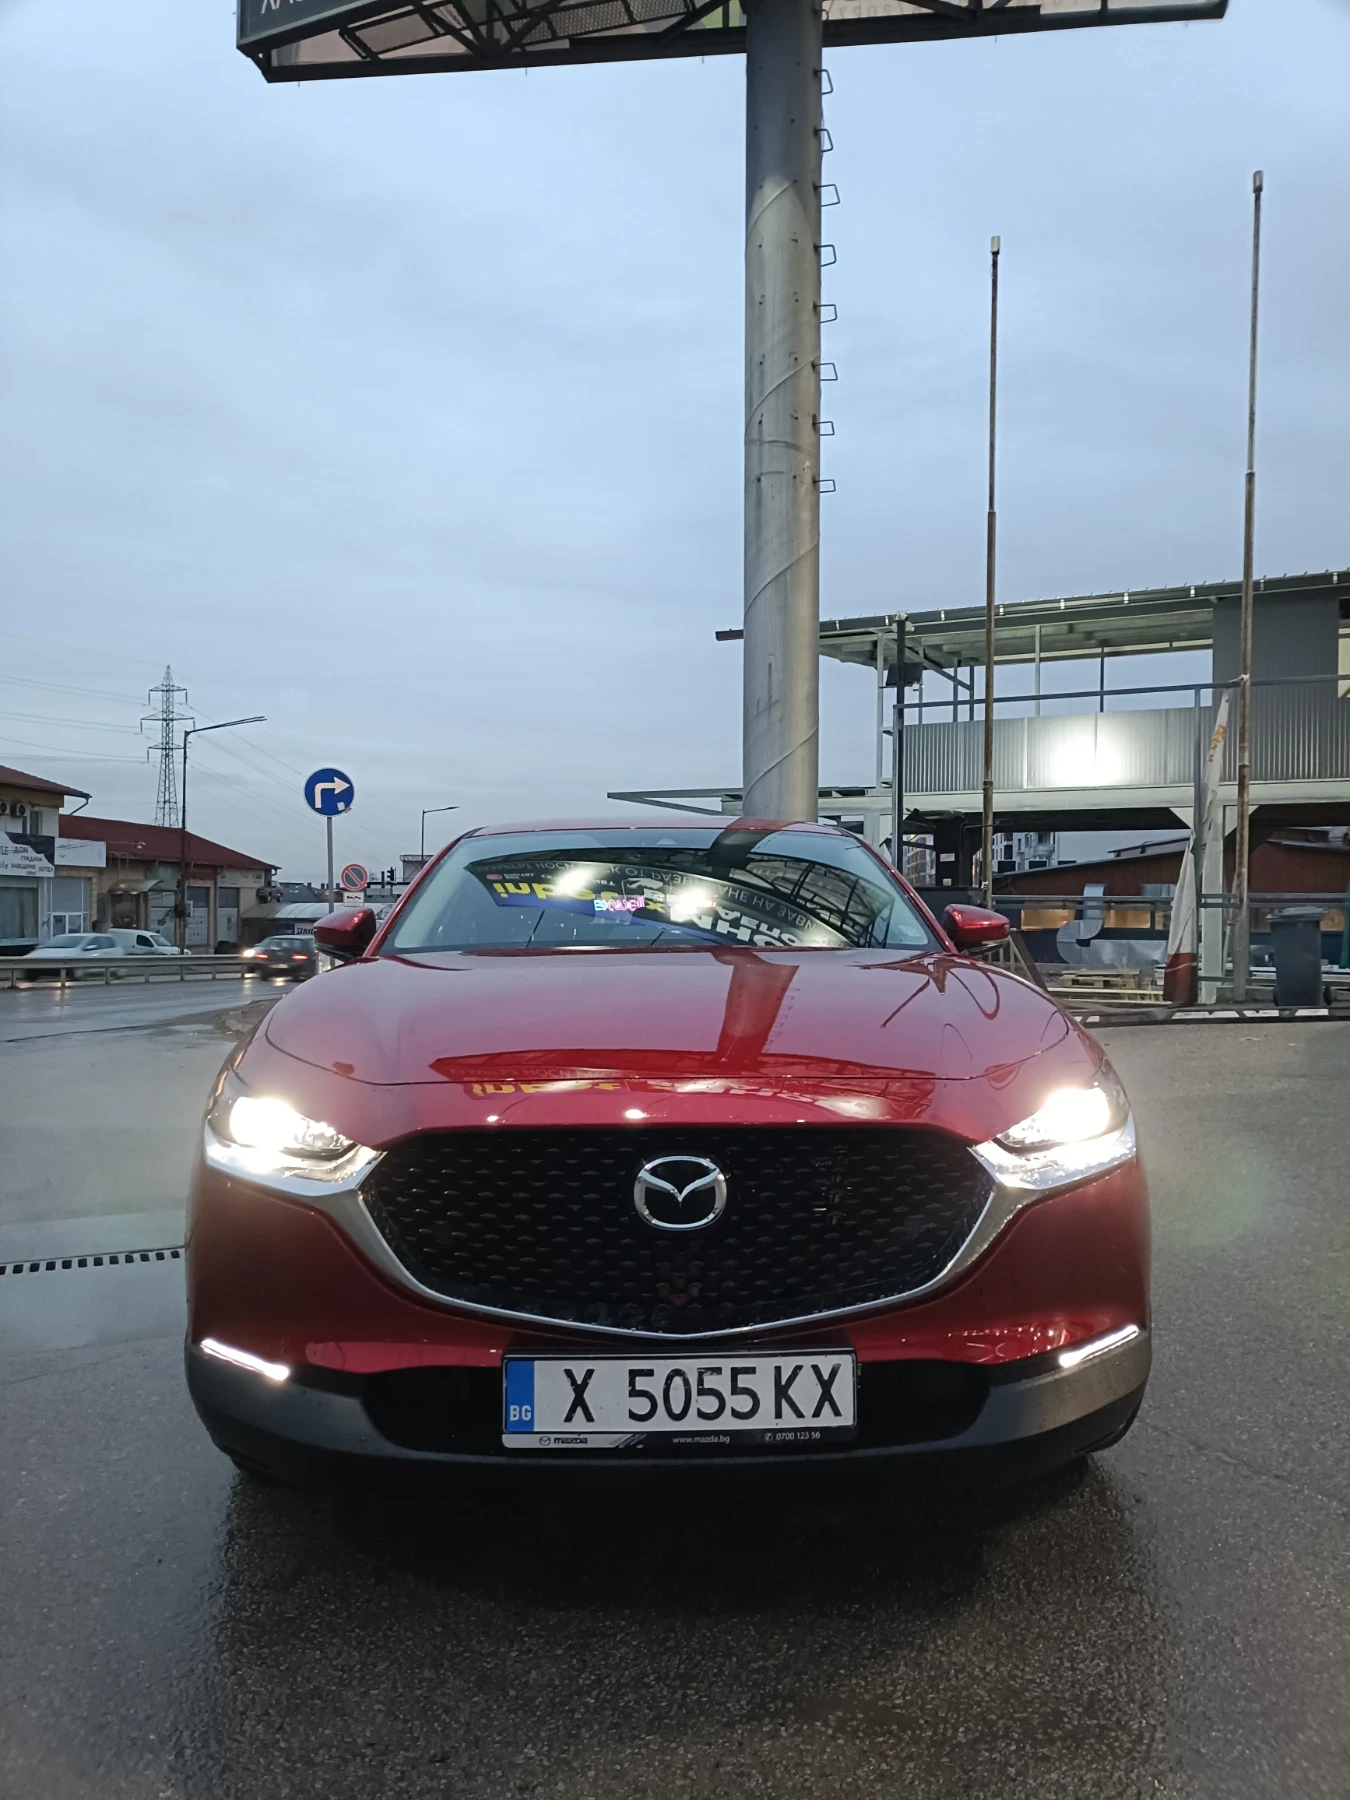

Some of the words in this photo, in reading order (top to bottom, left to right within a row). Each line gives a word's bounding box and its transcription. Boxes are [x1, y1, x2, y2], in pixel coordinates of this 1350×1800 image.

[509, 1404, 532, 1421] BG
[553, 1437, 588, 1445] mazda
[672, 1434, 731, 1444] www.mazda.bg
[775, 1432, 795, 1441] 0700
[796, 1432, 810, 1440] 123
[811, 1431, 821, 1440] 56
